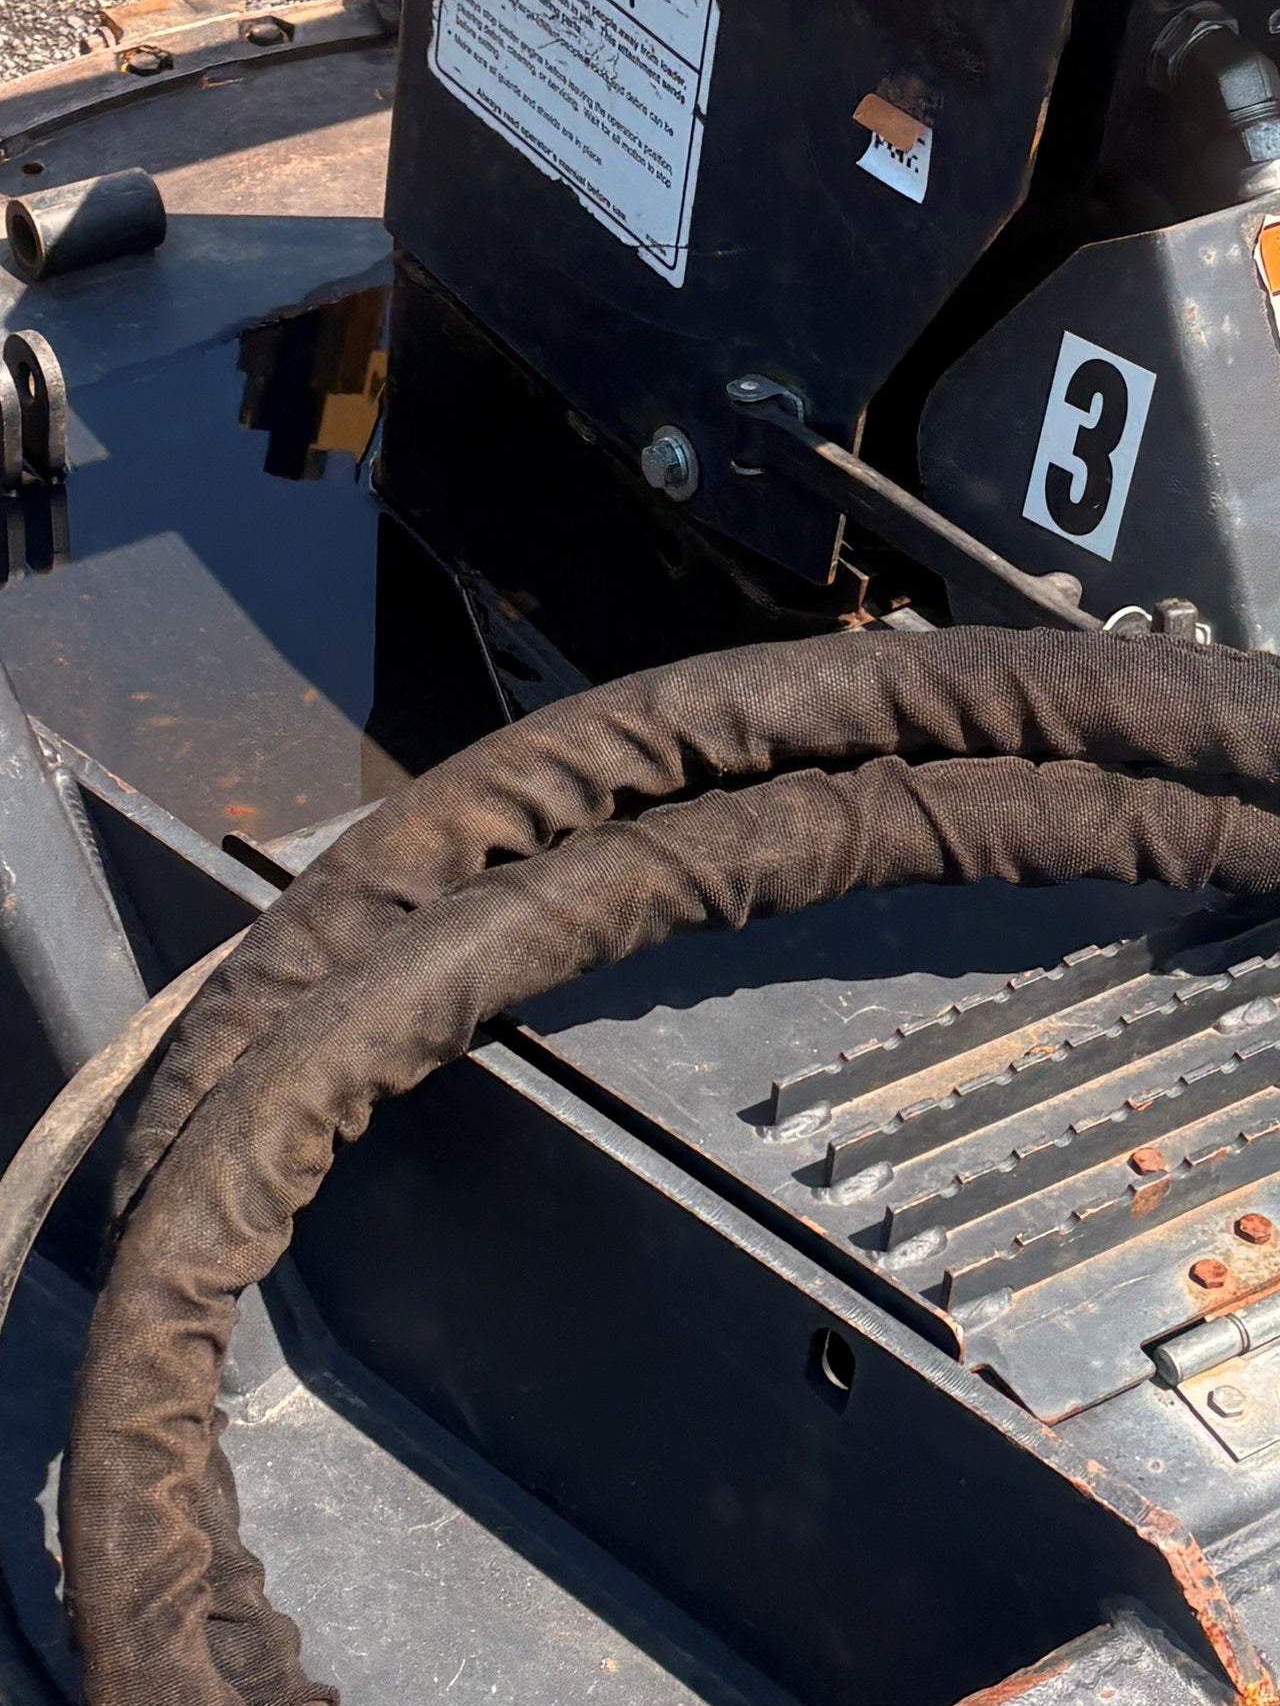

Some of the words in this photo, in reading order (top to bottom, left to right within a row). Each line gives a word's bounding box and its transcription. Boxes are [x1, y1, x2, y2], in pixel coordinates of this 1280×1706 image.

[476, 87, 502, 115] Always
[502, 111, 520, 129] read
[520, 125, 557, 162] operator's
[1045, 359, 1128, 536] 3
